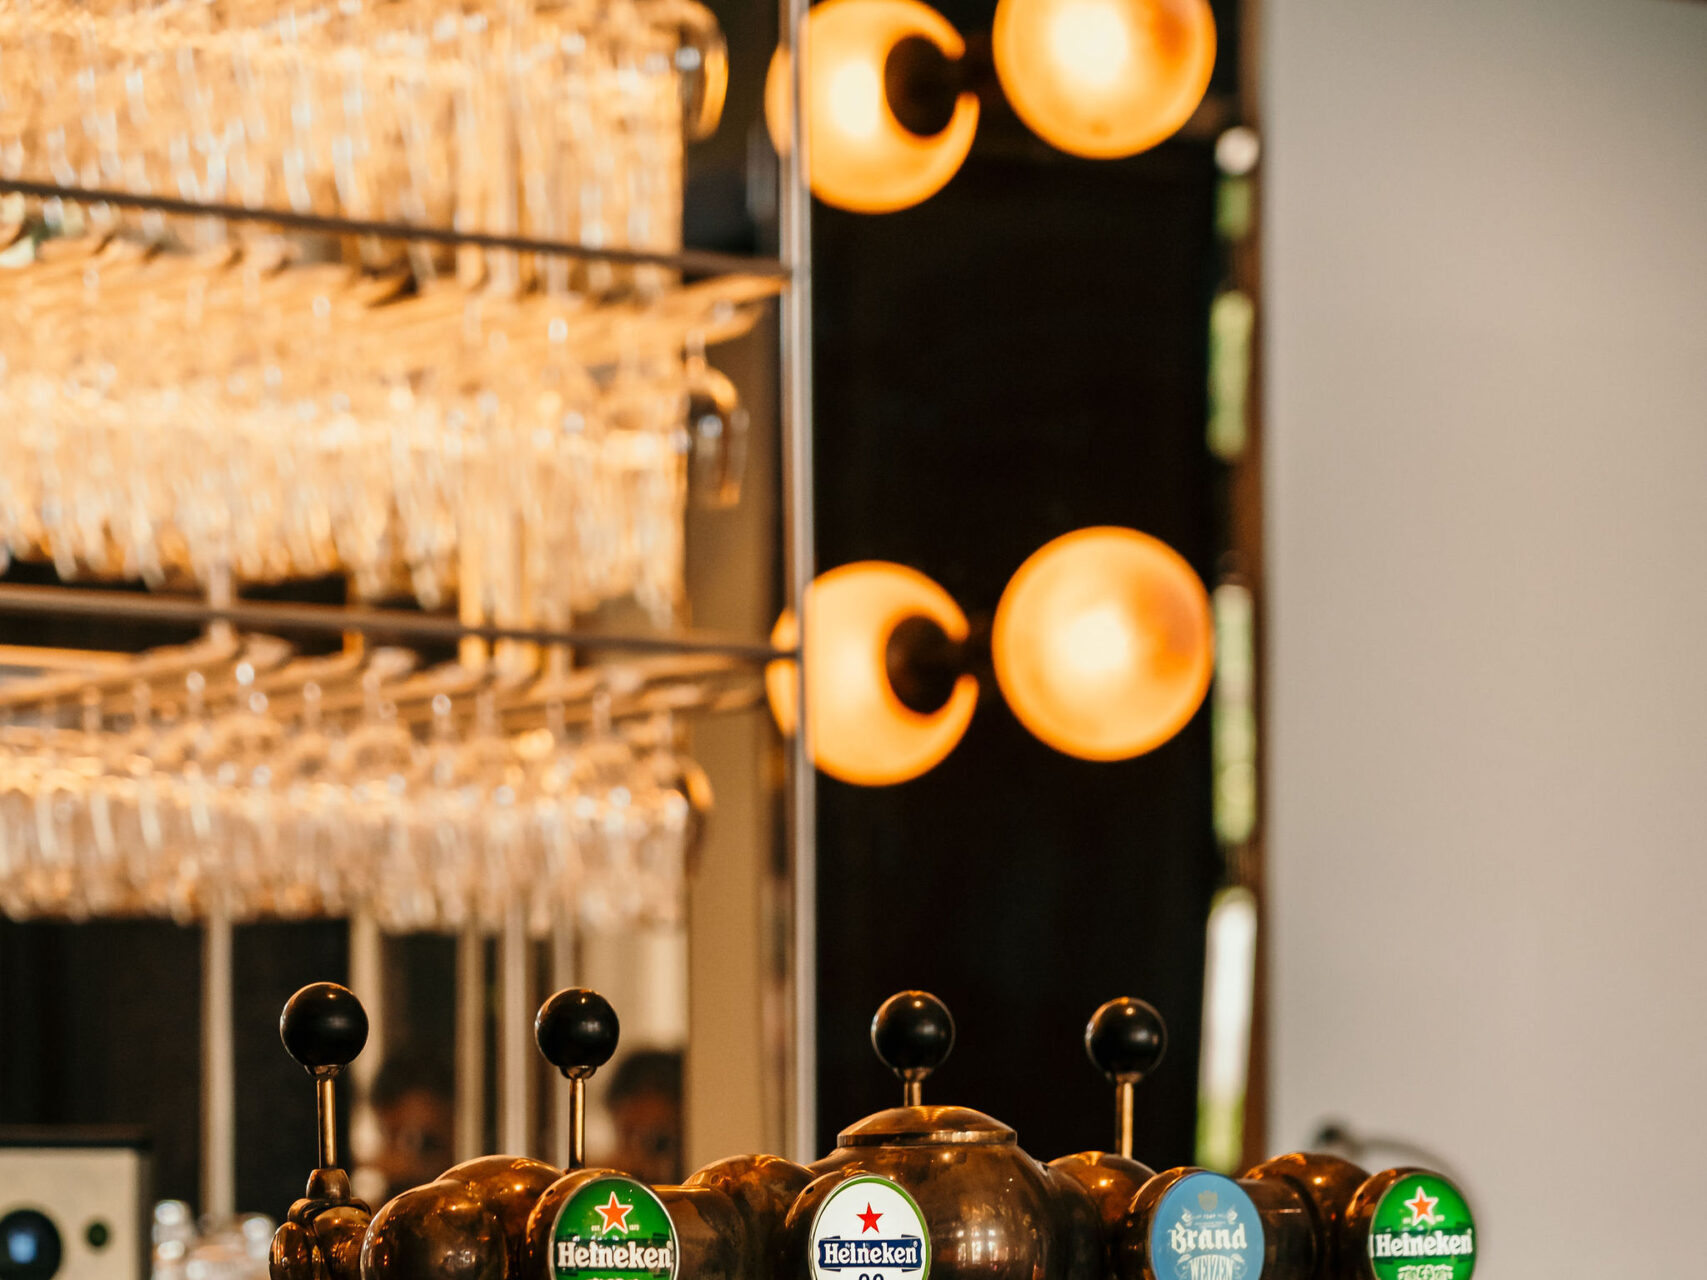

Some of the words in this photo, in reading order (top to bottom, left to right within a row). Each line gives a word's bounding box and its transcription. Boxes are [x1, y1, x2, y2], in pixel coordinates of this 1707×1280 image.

[1167, 1221, 1248, 1254] Brand
[1375, 1230, 1473, 1257] Heineken
[557, 1241, 672, 1269] Heineken
[824, 1242, 918, 1265] Heineken
